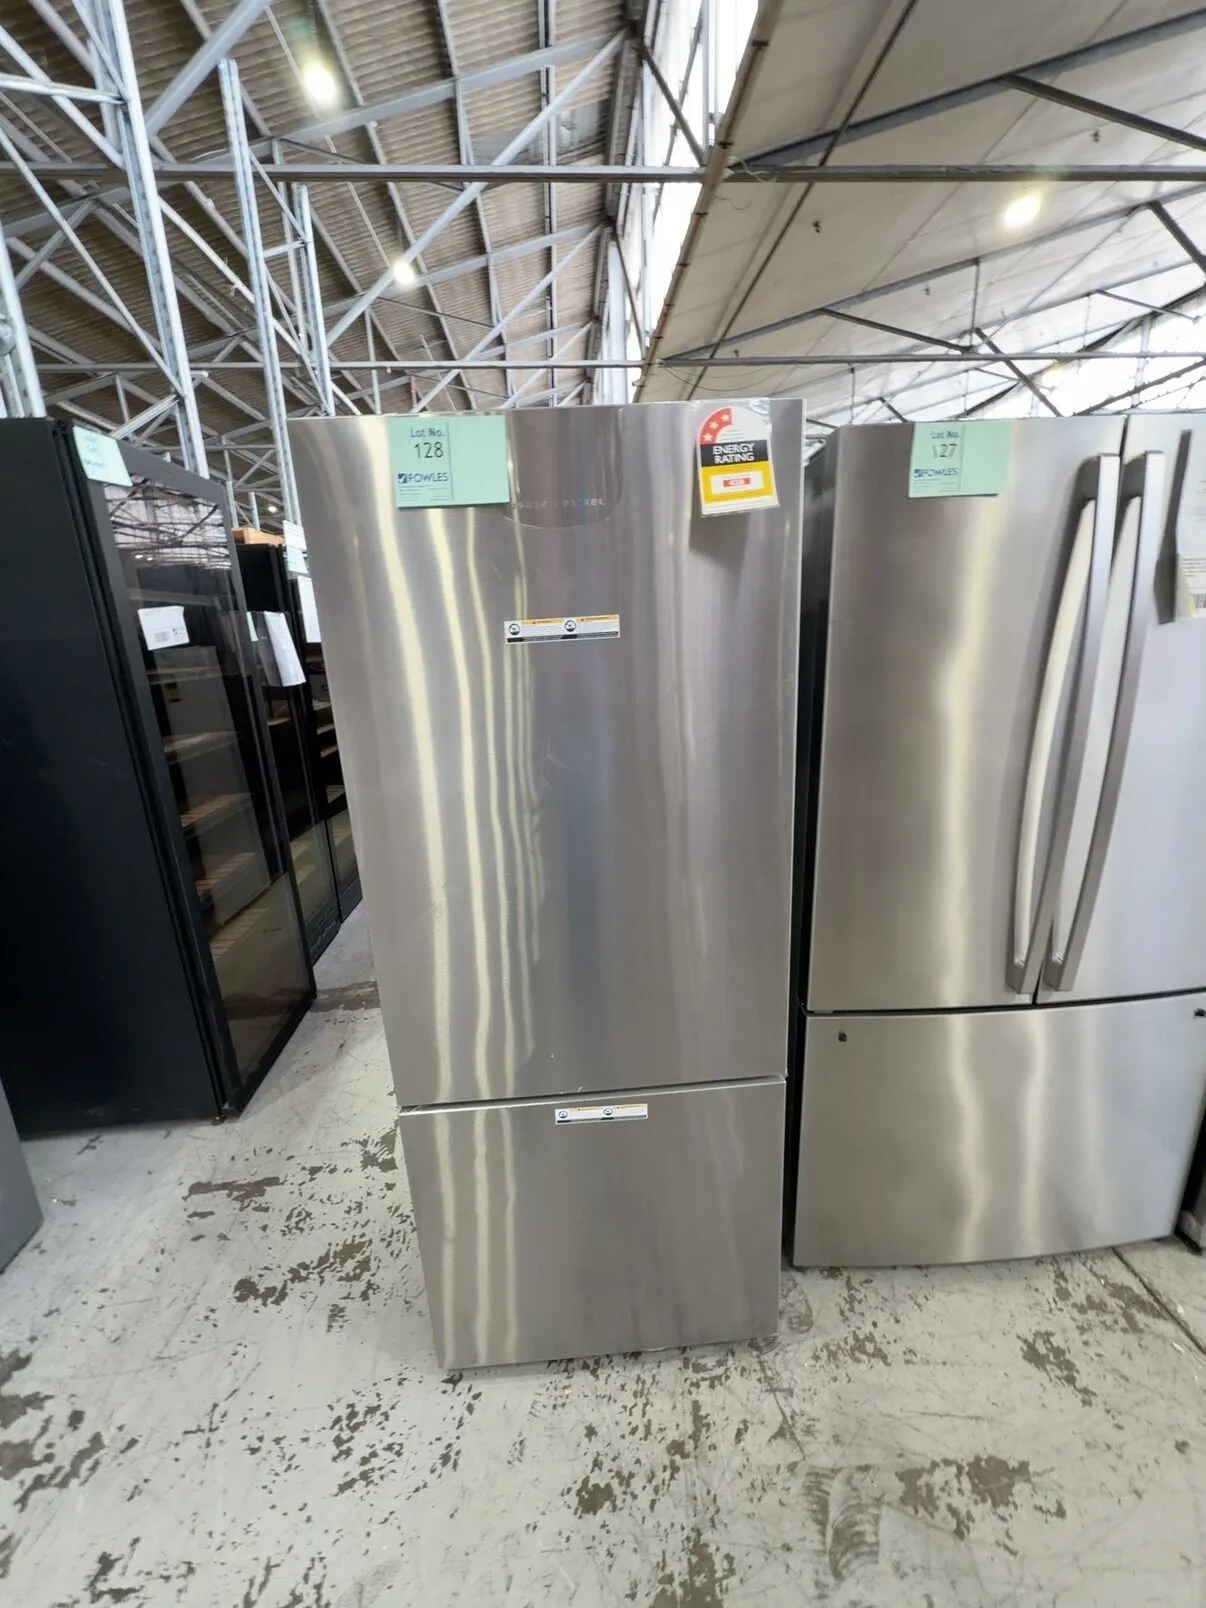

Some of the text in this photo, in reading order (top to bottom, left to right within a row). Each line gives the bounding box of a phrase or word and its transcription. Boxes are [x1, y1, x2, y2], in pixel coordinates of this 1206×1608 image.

[410, 427, 446, 438] Lot No.
[414, 441, 444, 459] 128
[712, 443, 755, 455] ENERGY
[931, 443, 958, 458] 127
[713, 453, 755, 464] RATING
[408, 472, 449, 483] FOWLES
